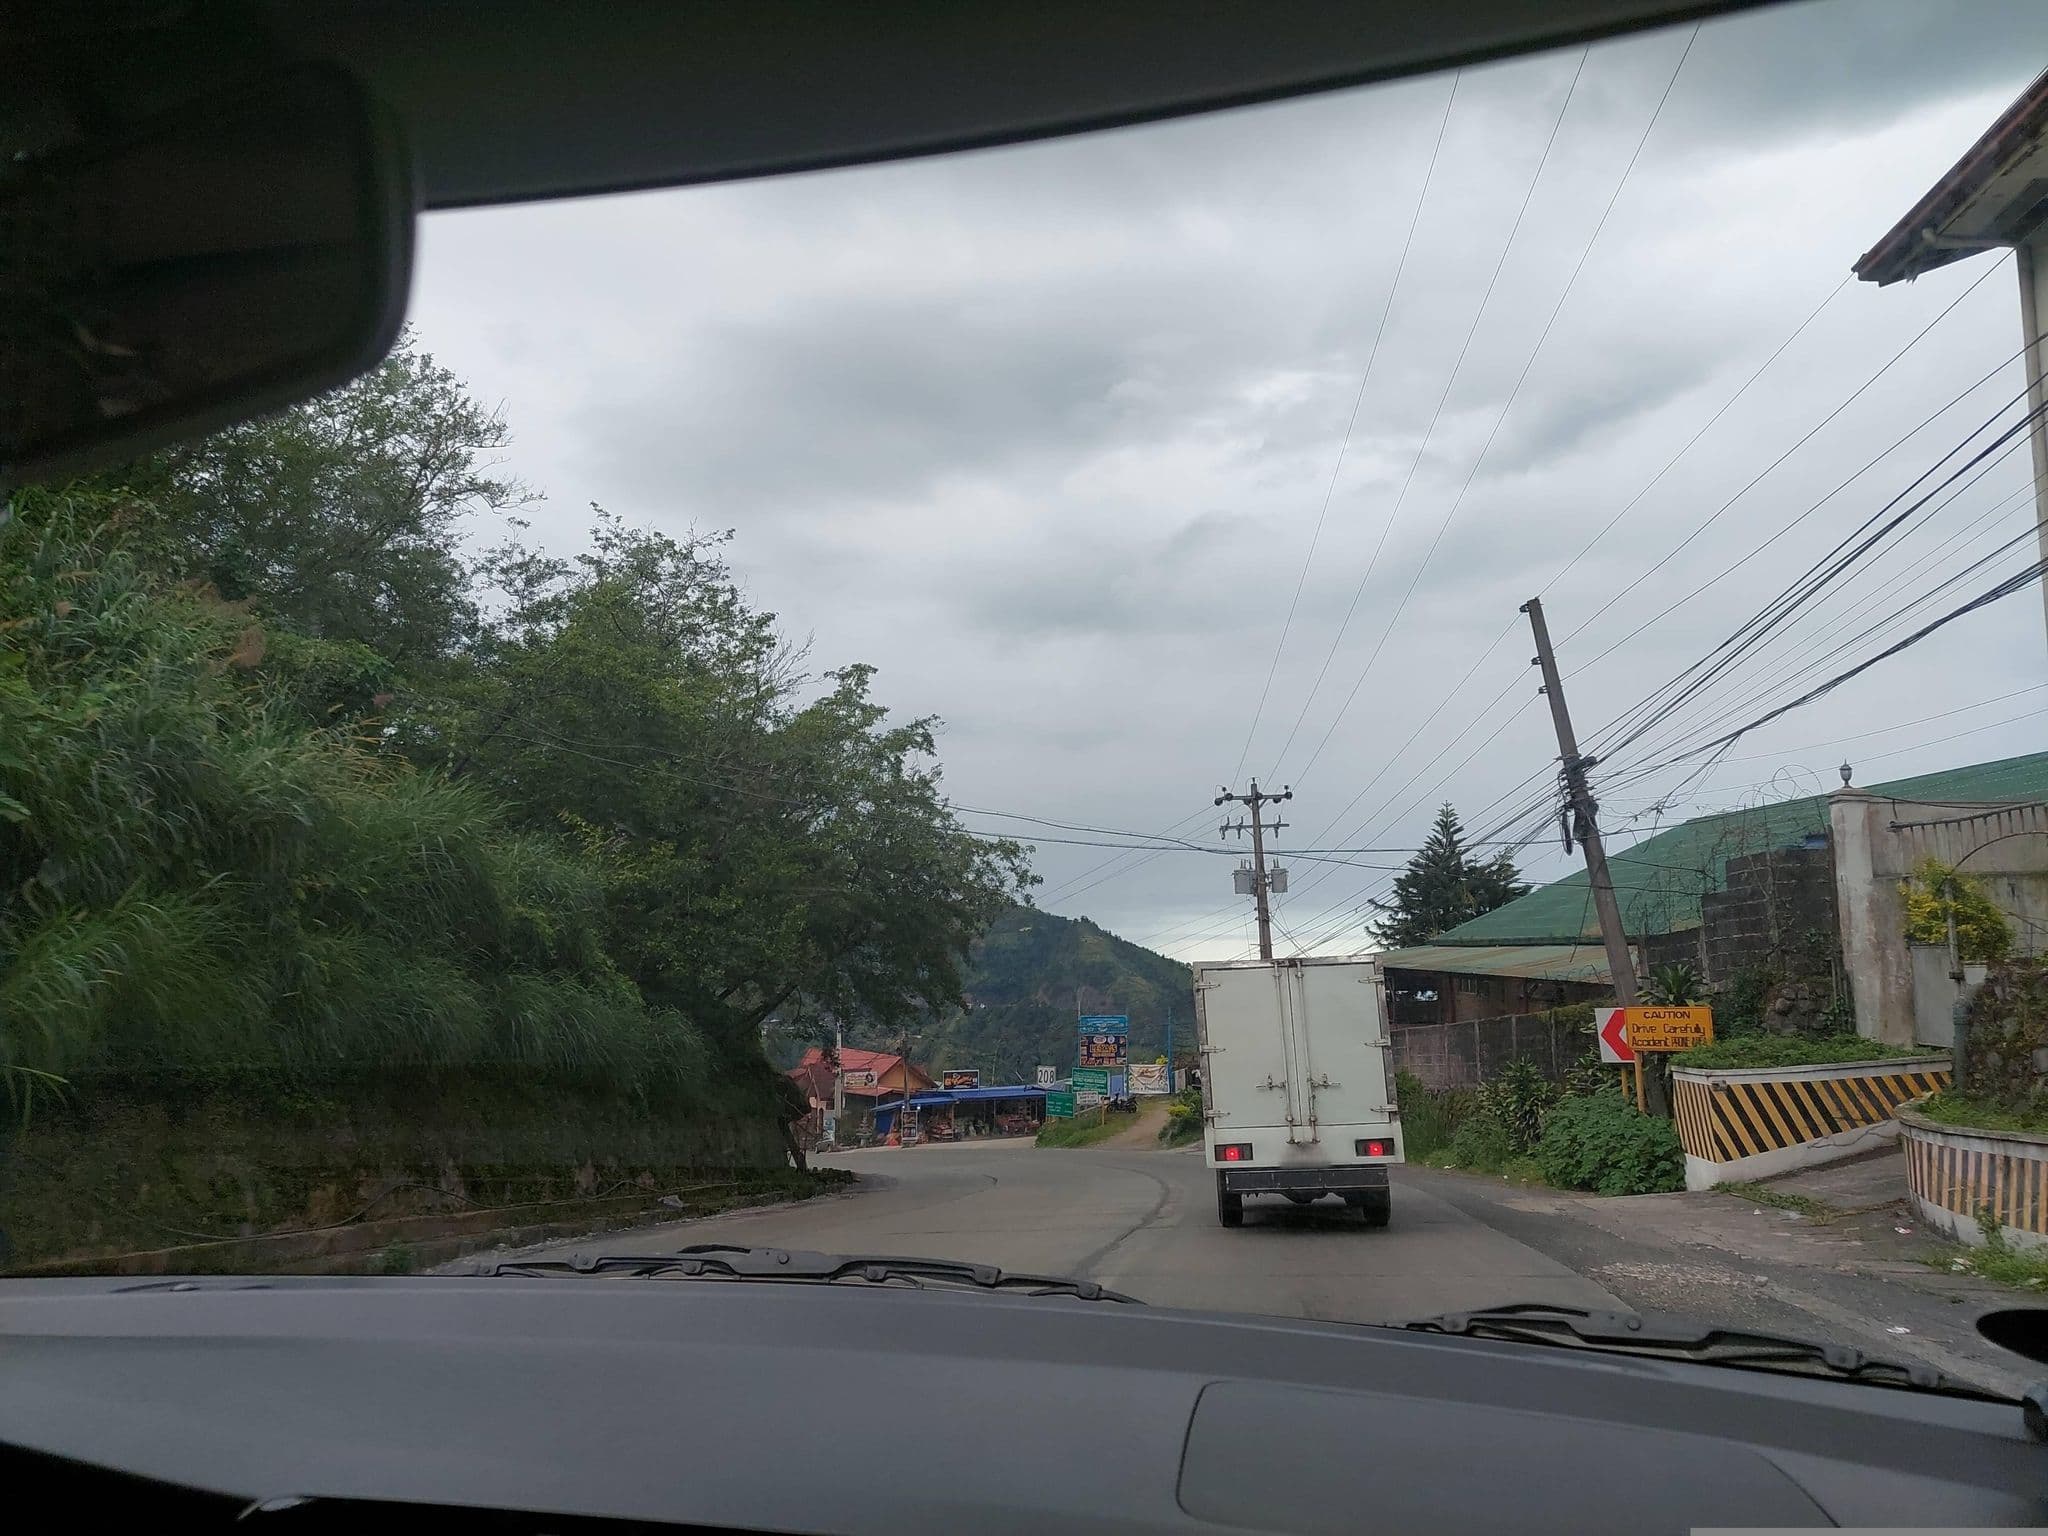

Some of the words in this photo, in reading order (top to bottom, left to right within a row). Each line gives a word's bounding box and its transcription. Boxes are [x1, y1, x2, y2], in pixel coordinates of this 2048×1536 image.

[1643, 1010, 1691, 1019] CAUTION
[1632, 1023, 1656, 1034] Drive
[1663, 1023, 1705, 1036] Carefully
[1632, 1036, 1670, 1047] Accident
[1038, 1070, 1054, 1084] 208
